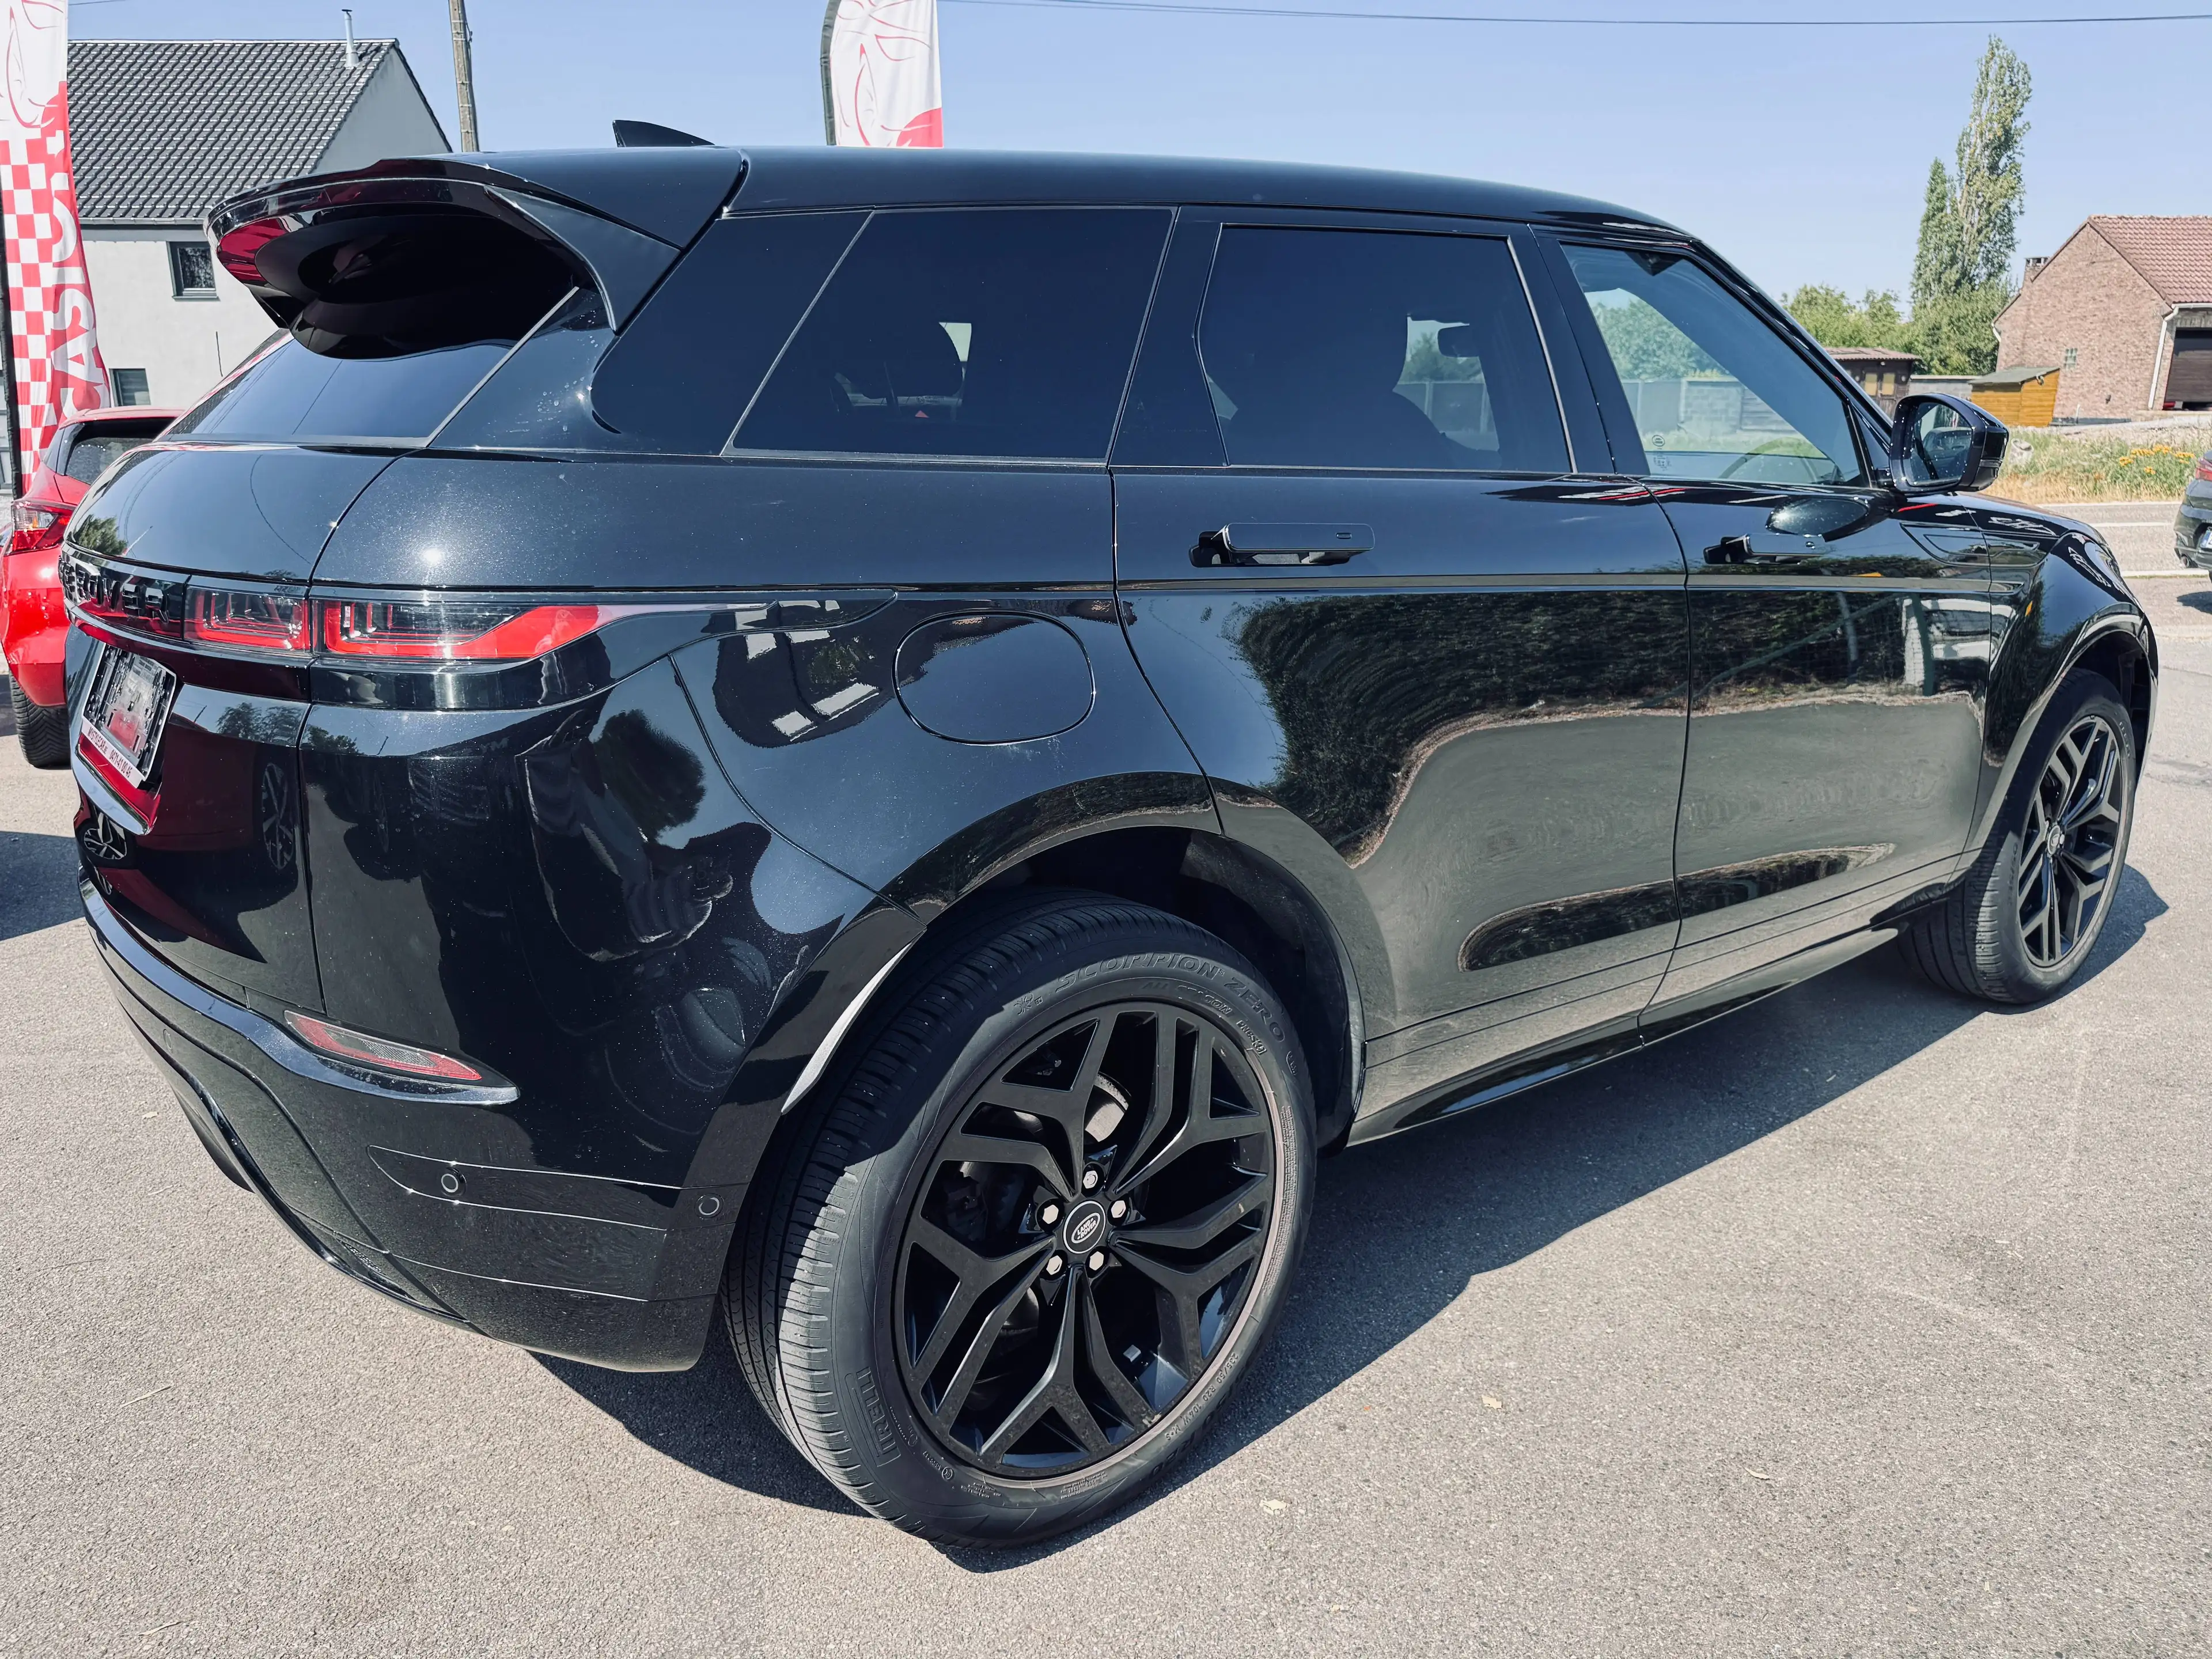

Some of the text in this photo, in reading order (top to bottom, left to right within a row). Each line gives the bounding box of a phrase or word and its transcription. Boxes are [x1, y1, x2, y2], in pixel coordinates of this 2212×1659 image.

[1224, 977, 1285, 1043] ZERO
[1077, 1219, 1092, 1236] LAND
[1080, 1219, 1097, 1240] ROVER
[1215, 1352, 1238, 1384] 235/50
[1202, 1384, 1217, 1402] R20
[845, 1366, 902, 1468] PIRELLI
[1183, 1402, 1202, 1426] 104W
